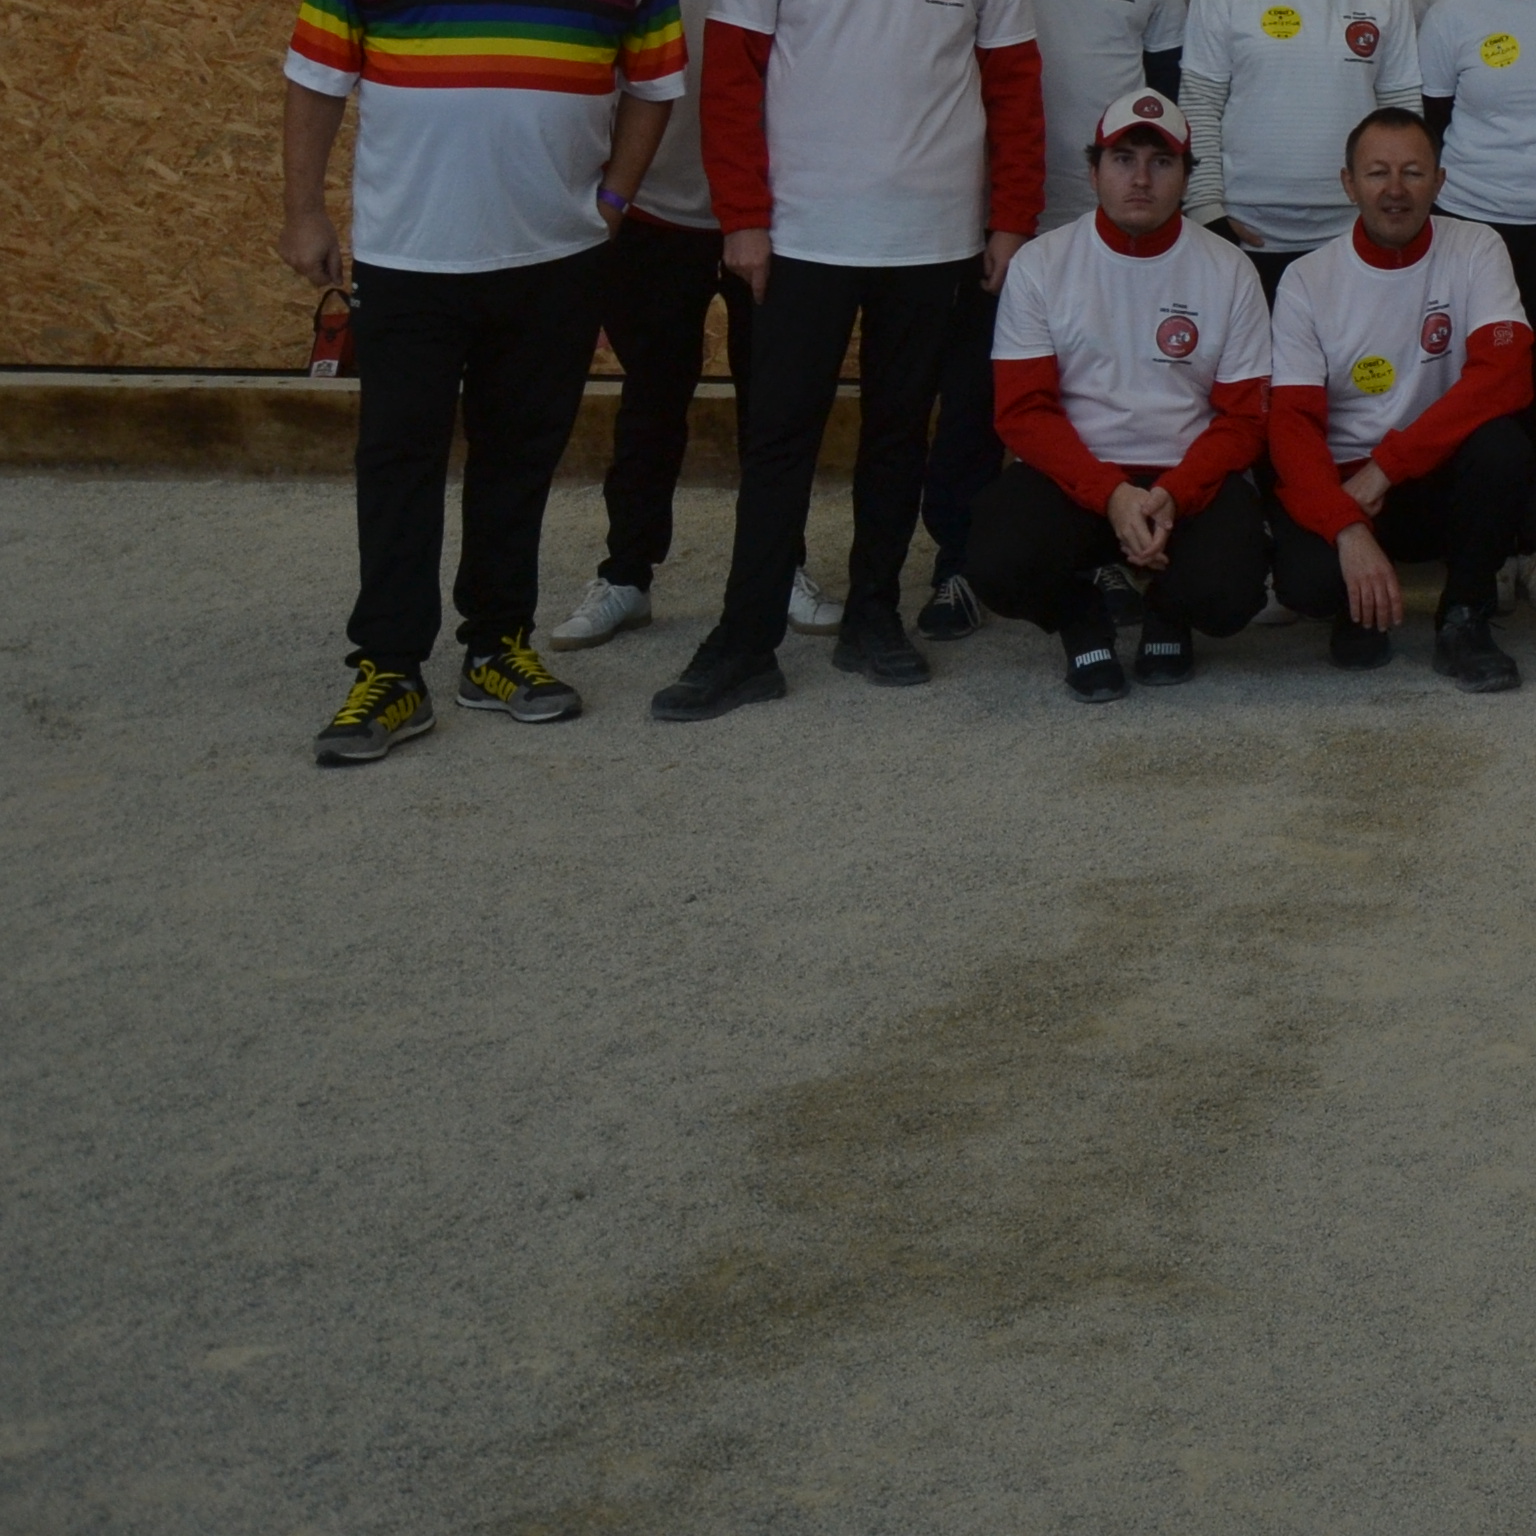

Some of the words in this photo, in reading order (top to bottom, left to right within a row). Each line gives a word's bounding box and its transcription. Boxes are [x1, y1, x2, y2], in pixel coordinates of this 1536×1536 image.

[1355, 369, 1392, 382] LAURENT
[1145, 642, 1181, 656] PUMA
[1075, 648, 1112, 669] PUMA
